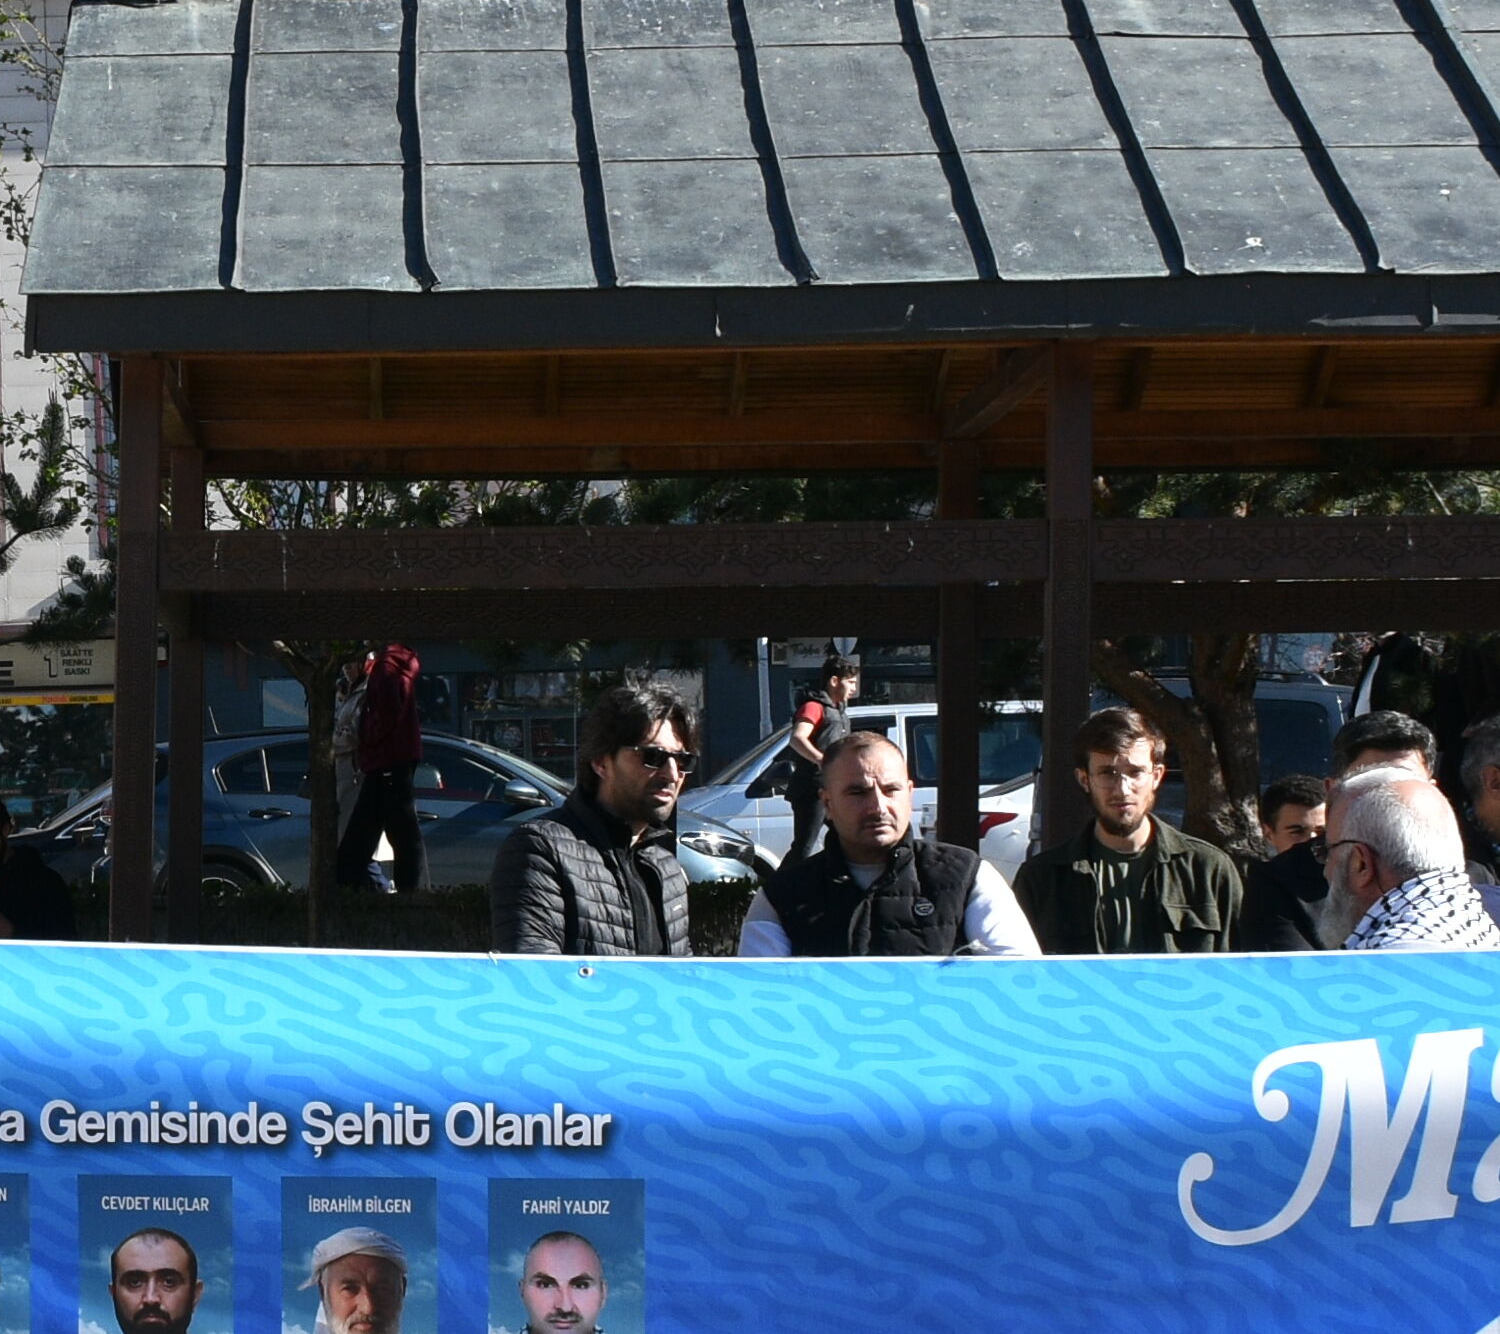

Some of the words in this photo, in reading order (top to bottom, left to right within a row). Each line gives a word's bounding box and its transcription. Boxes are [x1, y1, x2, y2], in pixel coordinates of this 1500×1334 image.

[40, 1099, 287, 1145] Gemisinde
[301, 1099, 430, 1158] Şehit
[444, 1100, 612, 1147] Olanlar
[101, 1195, 151, 1212] CEVDET
[152, 1196, 210, 1216] KILIÇLAR
[308, 1194, 363, 1214] İBRAHİM
[365, 1195, 412, 1214] BİLGEN
[522, 1196, 561, 1215] FAHRİ
[563, 1199, 611, 1216] YALDIZ
